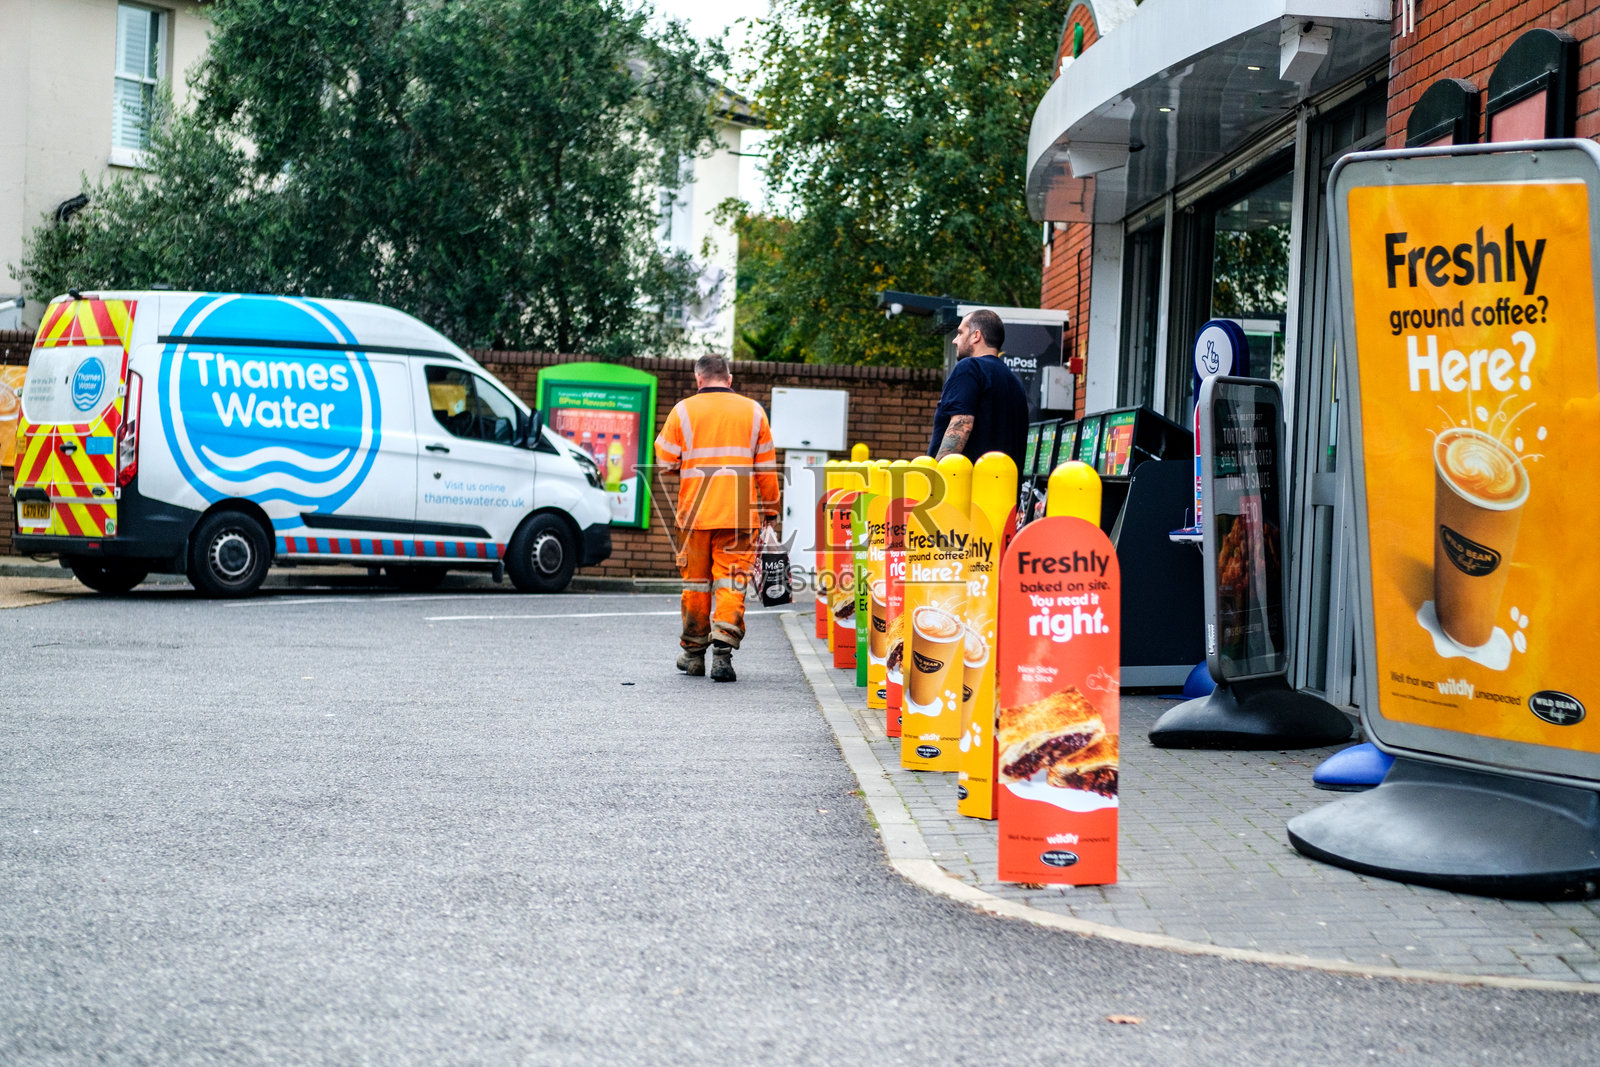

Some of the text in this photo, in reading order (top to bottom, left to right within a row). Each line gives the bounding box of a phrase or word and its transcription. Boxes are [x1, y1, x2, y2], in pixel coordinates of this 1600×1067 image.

[1385, 223, 1548, 296] Freshly
[1390, 295, 1549, 336] ground coffee?
[1004, 356, 1037, 369] InPost
[1407, 330, 1537, 392] Here?
[78, 372, 100, 382] Thames
[188, 352, 349, 392] Thames
[78, 382, 97, 390] Water
[211, 391, 335, 430] Water
[444, 481, 506, 493] Visit us online
[1226, 471, 1270, 491] TOMATO SAUCE
[424, 492, 525, 508] thameswater.co.uk
[868, 520, 885, 535] Fres
[886, 521, 907, 536] Fres
[908, 529, 969, 552] Freshly
[908, 551, 970, 564] ground coffee?
[1018, 550, 1110, 577] Freshly
[1466, 549, 1493, 563] BEAN
[765, 560, 784, 570] M&S
[912, 561, 963, 582] Here?
[966, 574, 989, 598] re?
[1020, 580, 1111, 593] baked on site.
[1029, 592, 1100, 607] You read it
[1029, 606, 1110, 643] right.
[1017, 664, 1036, 674] New
[1437, 678, 1475, 700] wildly
[1475, 689, 1522, 706] unexpected
[1535, 697, 1578, 711] WILD BEAN
[919, 733, 940, 742] wildly
[1046, 832, 1079, 845] wildly
